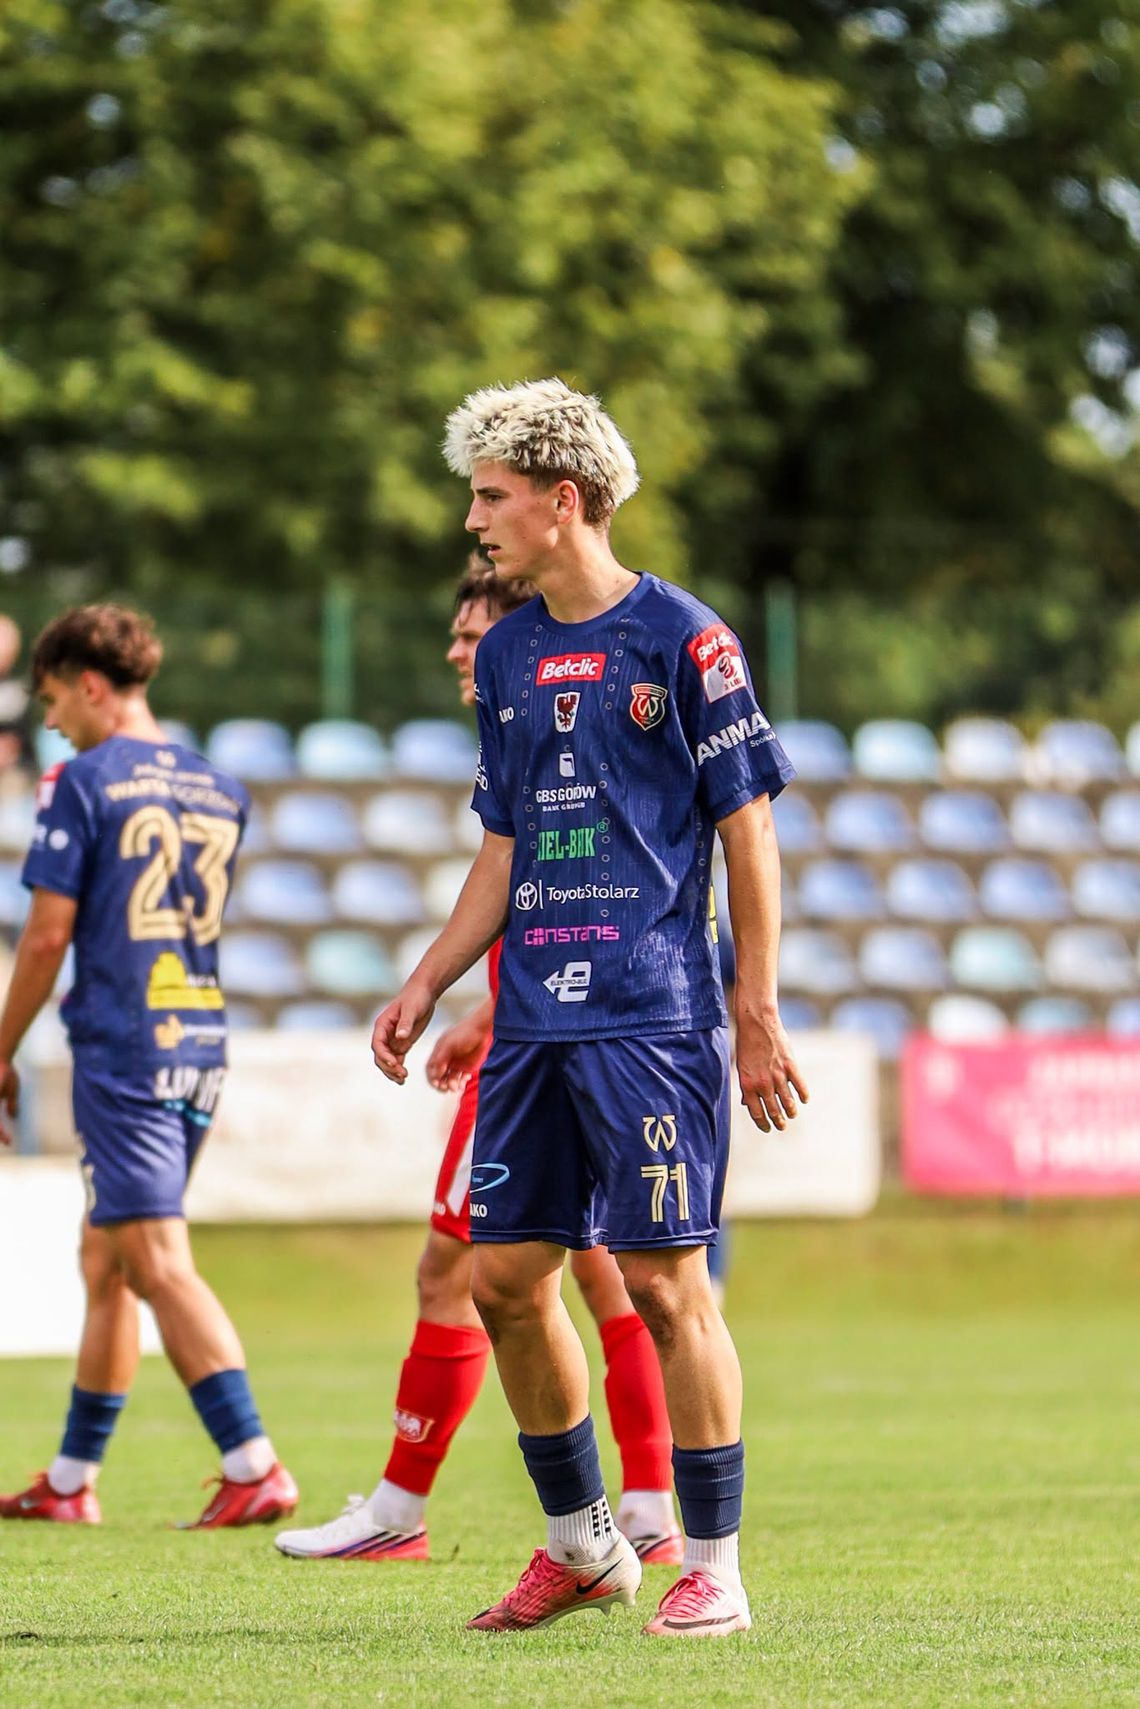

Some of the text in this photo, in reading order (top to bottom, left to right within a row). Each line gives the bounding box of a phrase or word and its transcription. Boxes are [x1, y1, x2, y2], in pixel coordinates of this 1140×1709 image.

[541, 656, 599, 680] Betclic
[119, 805, 240, 947] 23
[469, 1203, 488, 1219] AKO
[640, 1162, 690, 1223] 71
